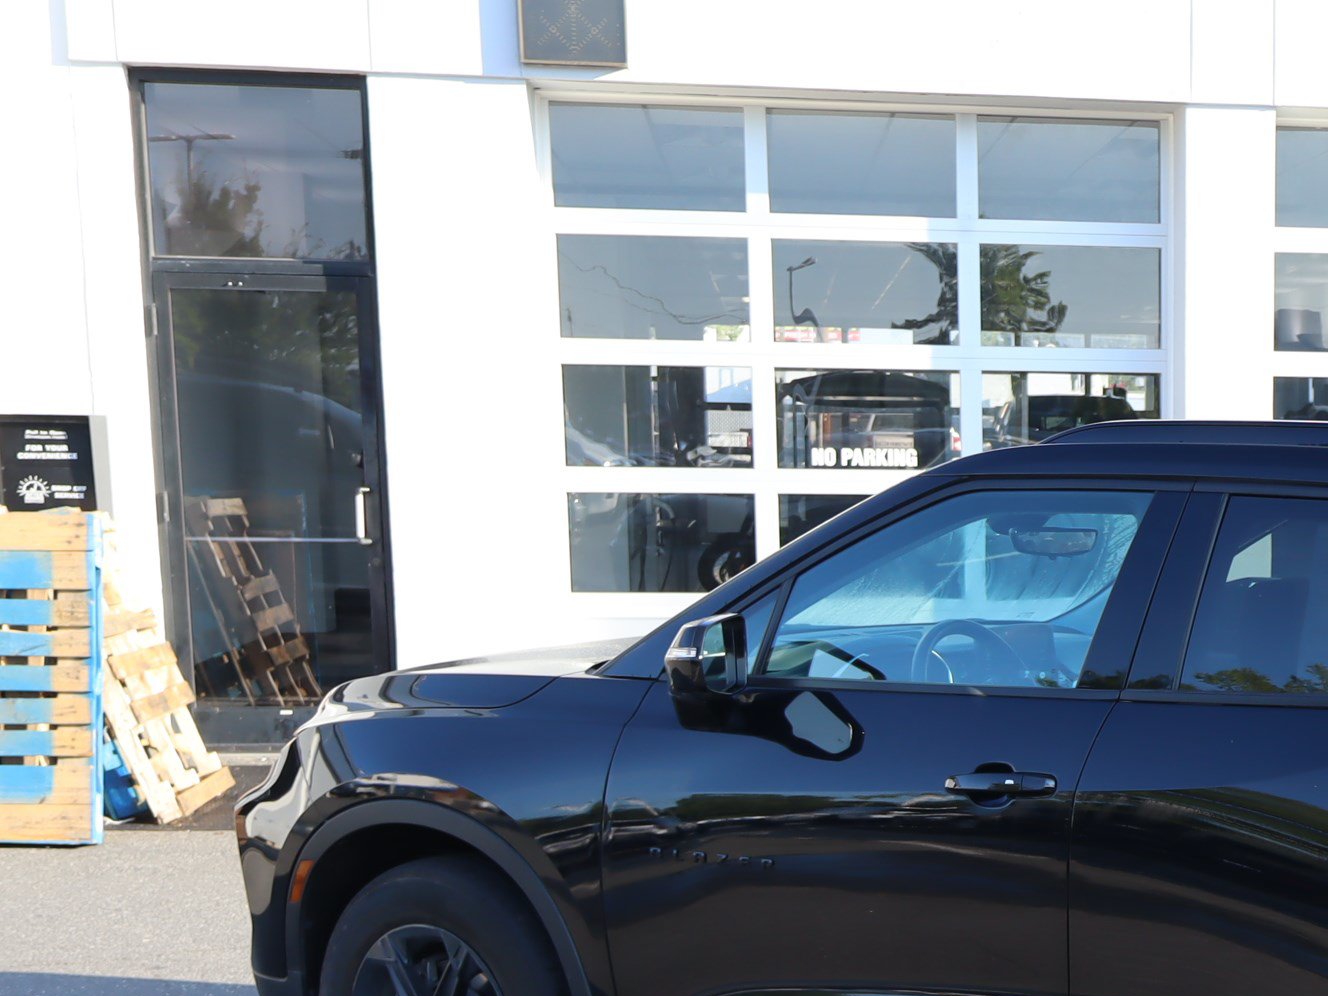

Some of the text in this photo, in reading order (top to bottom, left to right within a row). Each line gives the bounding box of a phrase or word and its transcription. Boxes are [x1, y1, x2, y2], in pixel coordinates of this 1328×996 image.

[25, 444, 68, 452] FOR YOUR
[17, 452, 78, 460] CONVENIENCE
[811, 447, 918, 467] NO PARKING
